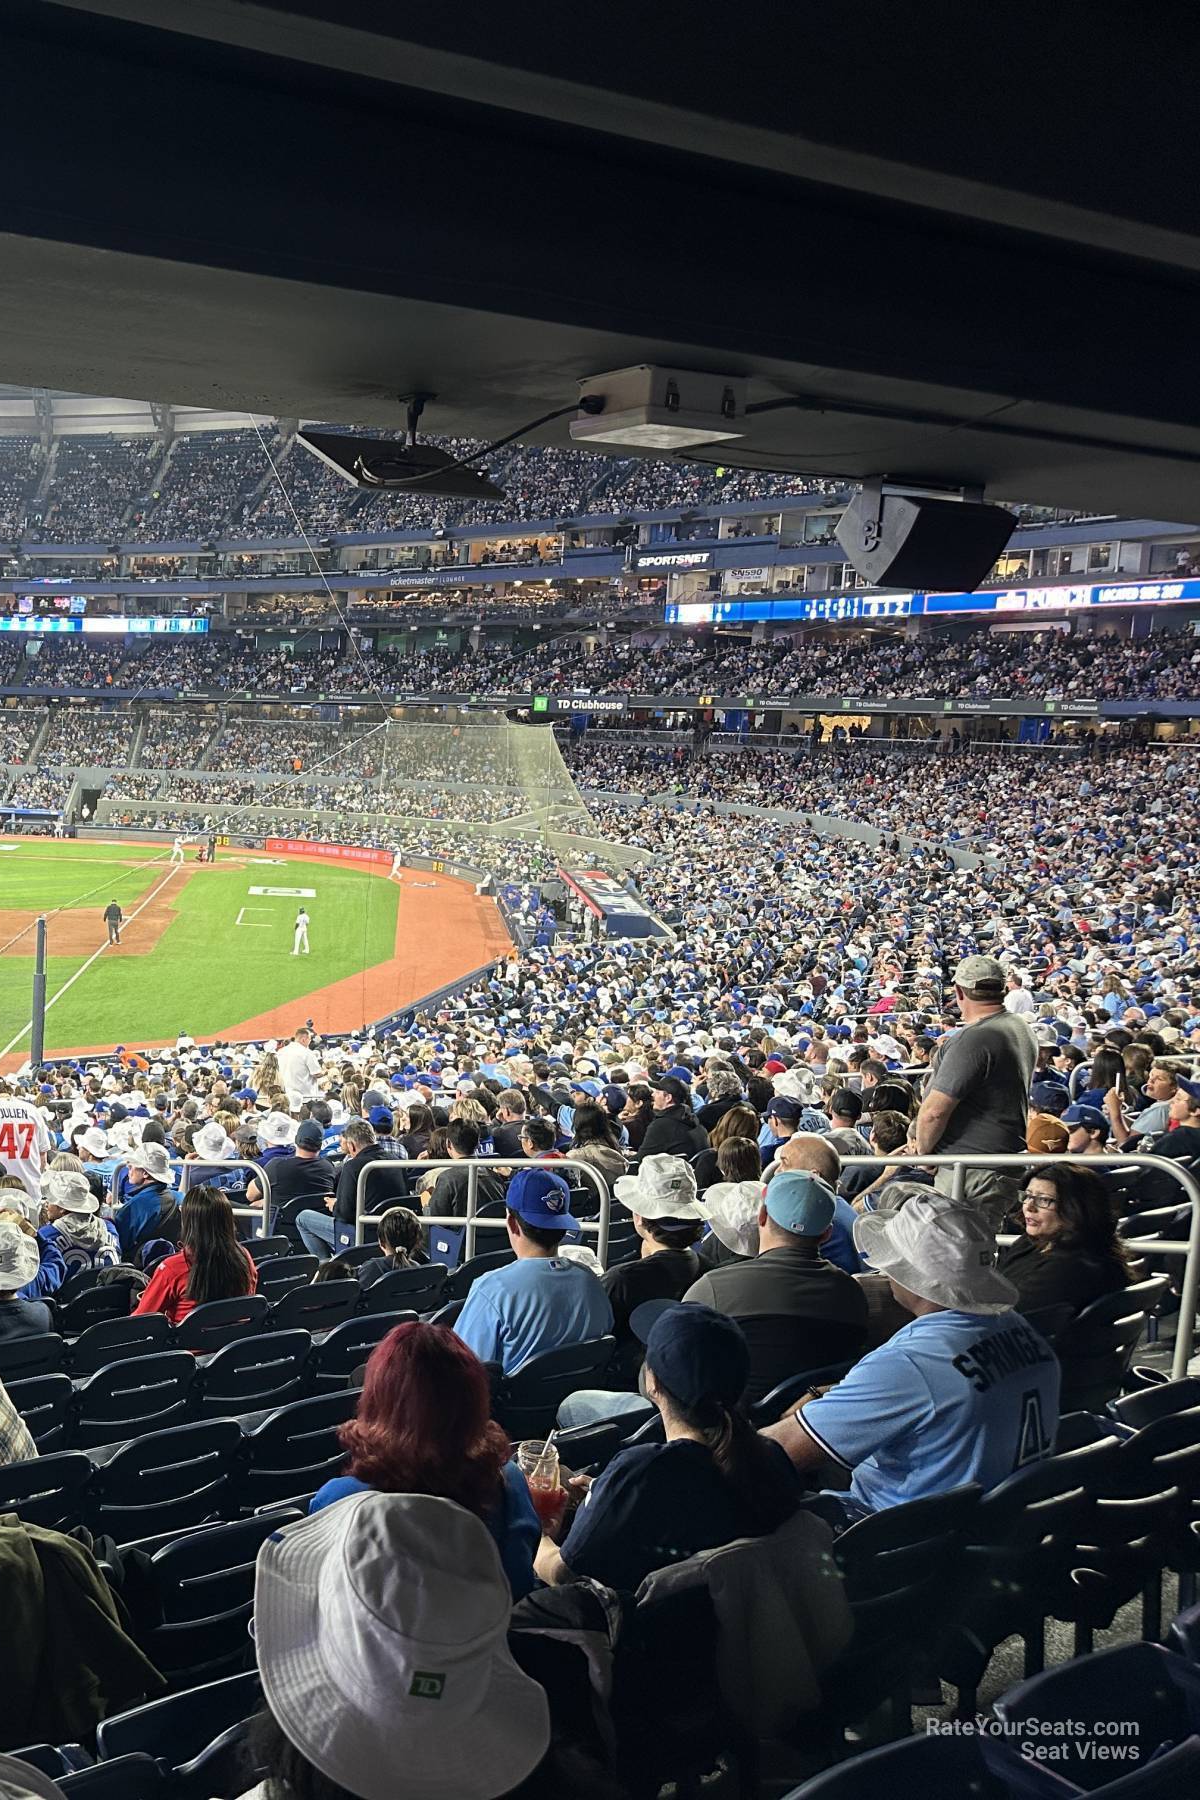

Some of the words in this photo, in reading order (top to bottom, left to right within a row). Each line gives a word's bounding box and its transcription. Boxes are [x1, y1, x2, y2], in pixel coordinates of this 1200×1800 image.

[638, 553, 710, 567] SPORTSNET
[731, 568, 762, 577] SN590
[390, 576, 436, 586] ticketmaster
[557, 700, 570, 709] TD
[571, 699, 624, 710] Clubhouse
[0, 1107, 29, 1120] JULIEN
[1012, 1388, 1054, 1474] 4
